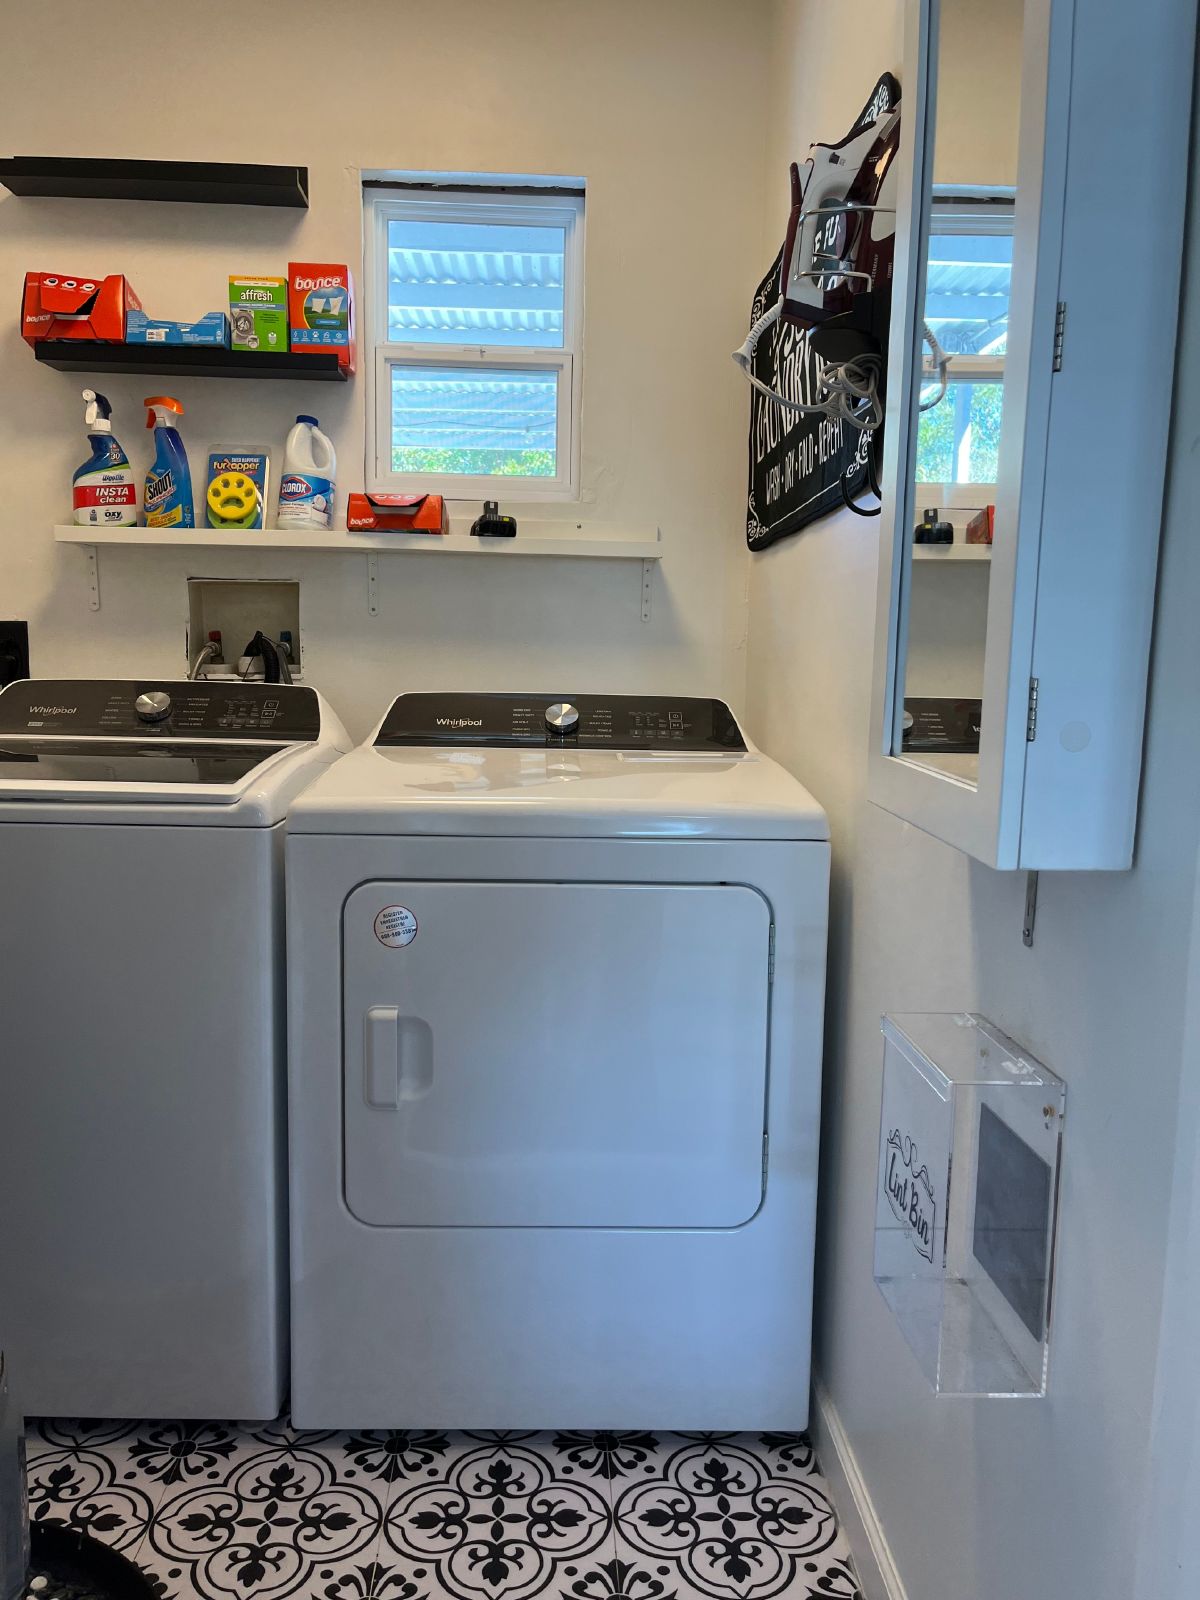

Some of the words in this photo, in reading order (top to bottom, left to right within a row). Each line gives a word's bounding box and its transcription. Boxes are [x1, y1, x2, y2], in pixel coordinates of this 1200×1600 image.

[295, 276, 342, 291] bounce
[240, 289, 273, 302] affresh
[25, 314, 51, 323] bounce
[798, 433, 813, 480] FOLD
[95, 487, 129, 496] INSTA
[281, 482, 307, 493] CLOROX
[350, 517, 375, 526] bounce
[29, 705, 77, 716] Whirlpool
[436, 718, 483, 729] Whirlpool
[887, 1151, 908, 1212] Lint
[908, 1181, 930, 1246] Bin
